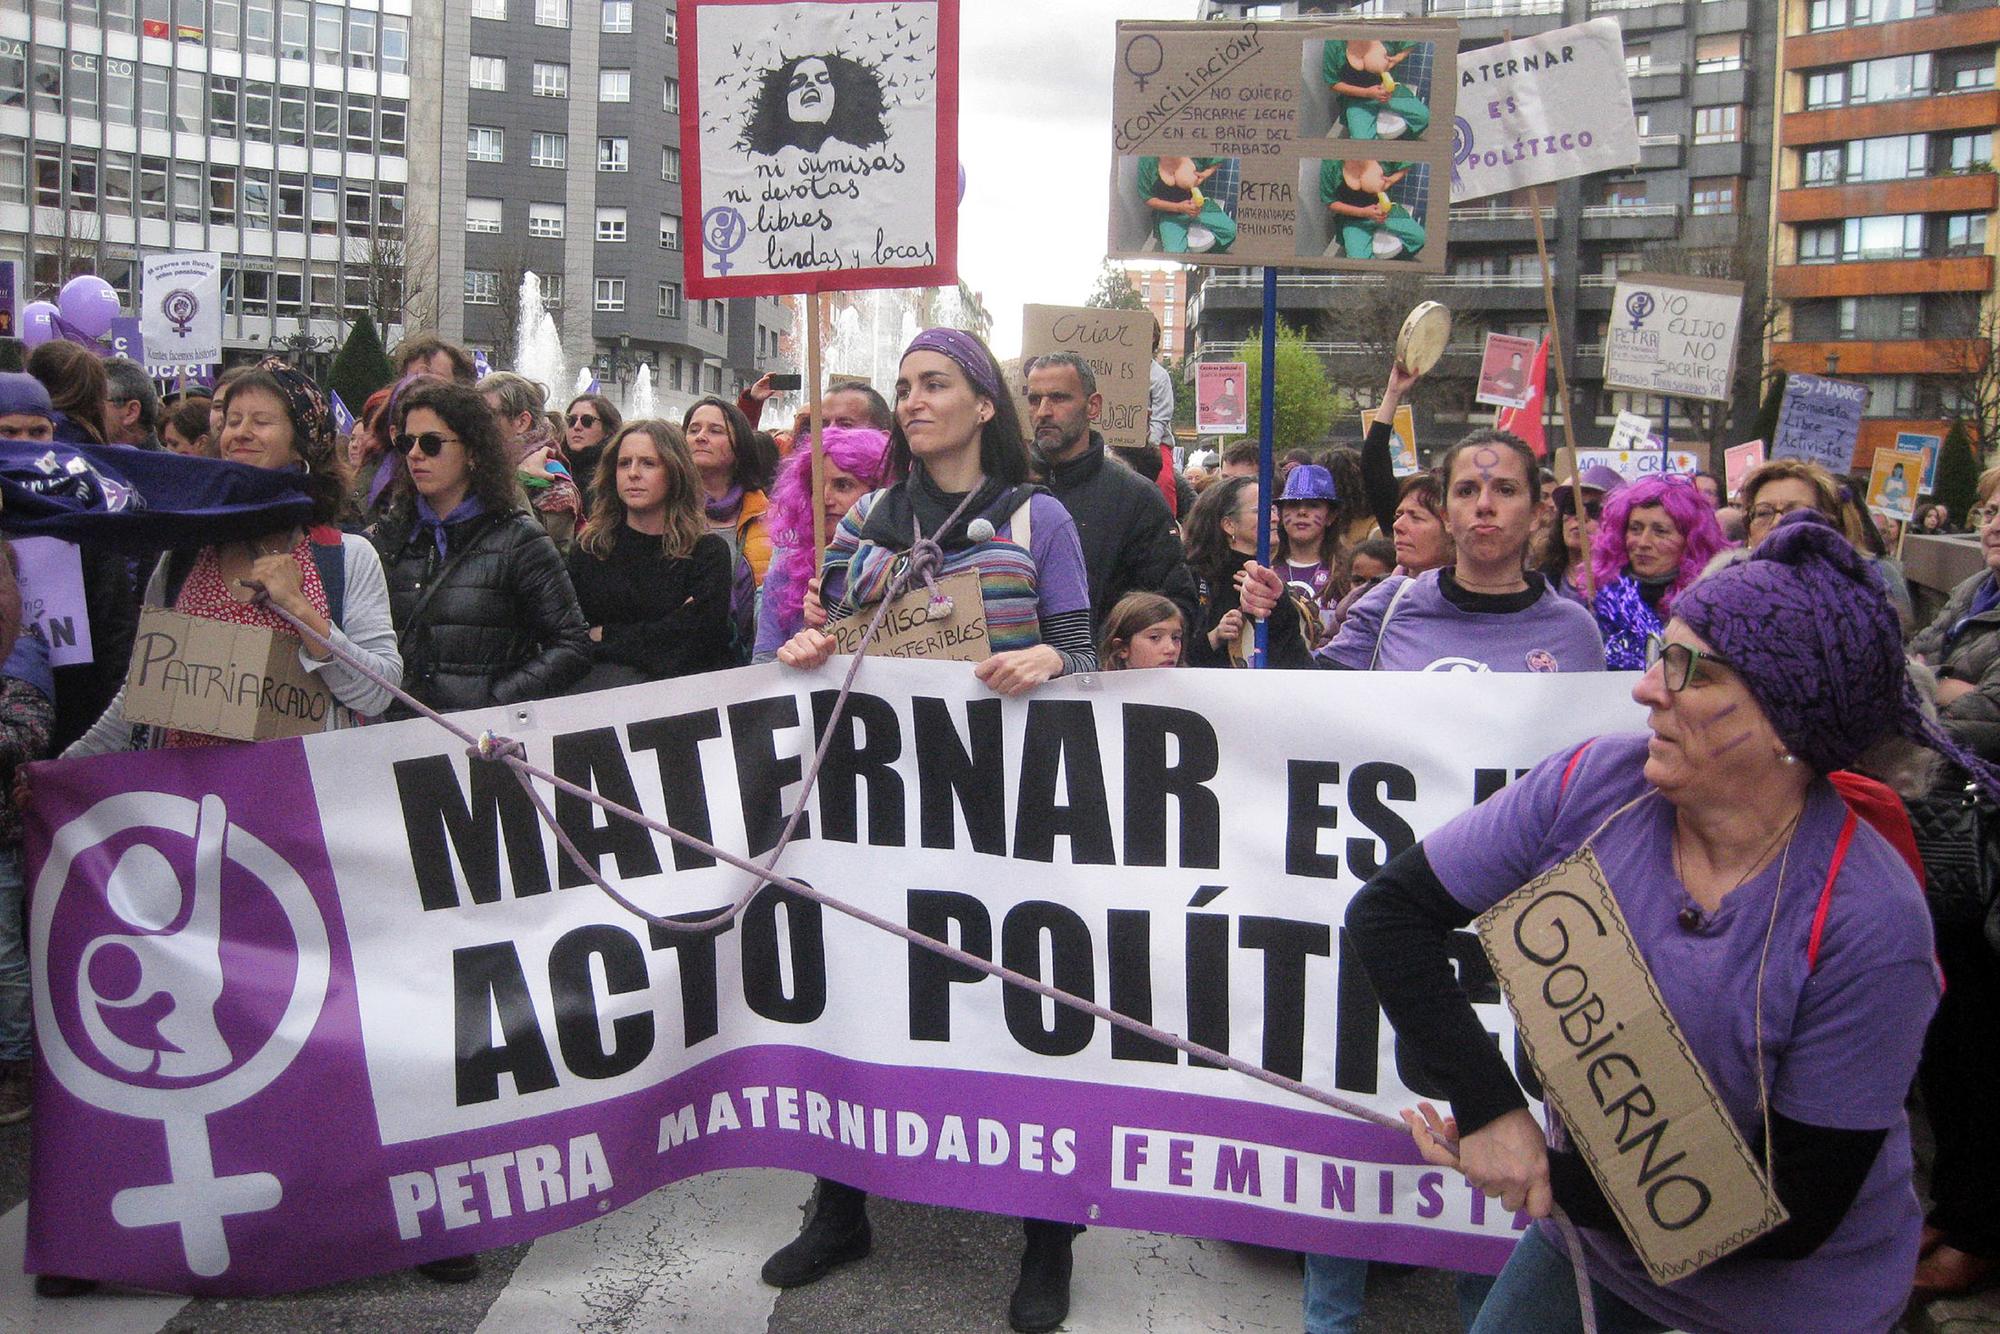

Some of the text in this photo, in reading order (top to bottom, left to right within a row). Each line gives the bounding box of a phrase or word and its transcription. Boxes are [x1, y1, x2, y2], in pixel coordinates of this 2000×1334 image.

[1461, 46, 1574, 87] ATERNAR
[1210, 84, 1292, 101] NO QUIERO
[1182, 107, 1296, 121] SACARME LECHE
[1488, 96, 1516, 119] ES
[1162, 125, 1292, 141] EN EL BAÑO DEL
[1210, 143, 1281, 155] TRABAJO
[1468, 131, 1593, 170] POLÍTICO
[755, 152, 905, 179] ni sumisas
[723, 176, 860, 203] ni devotas
[1240, 180, 1292, 202] PETRA
[747, 205, 832, 233] libres
[759, 228, 934, 271] lindas y locas
[1661, 291, 1688, 316] YO
[1052, 314, 1133, 347] Criar
[1614, 327, 1659, 348] PETRA
[1668, 317, 1726, 340] ELIJO
[1683, 341, 1716, 361] NO
[1121, 362, 1134, 380] ES
[1786, 375, 1865, 401] Soy MADRE
[1784, 412, 1822, 432] Libre
[1637, 456, 1677, 472] CRA
[836, 607, 943, 655] PERMISO
[138, 632, 325, 722] PATRIARCADO
[393, 690, 1417, 912] MATERNAR ES
[453, 877, 1544, 1106] ACTO POLÍTI
[1513, 890, 1712, 1231] GOBIERNO
[389, 1086, 1533, 1241] PETRA MATERNIDADES FEMINIST
